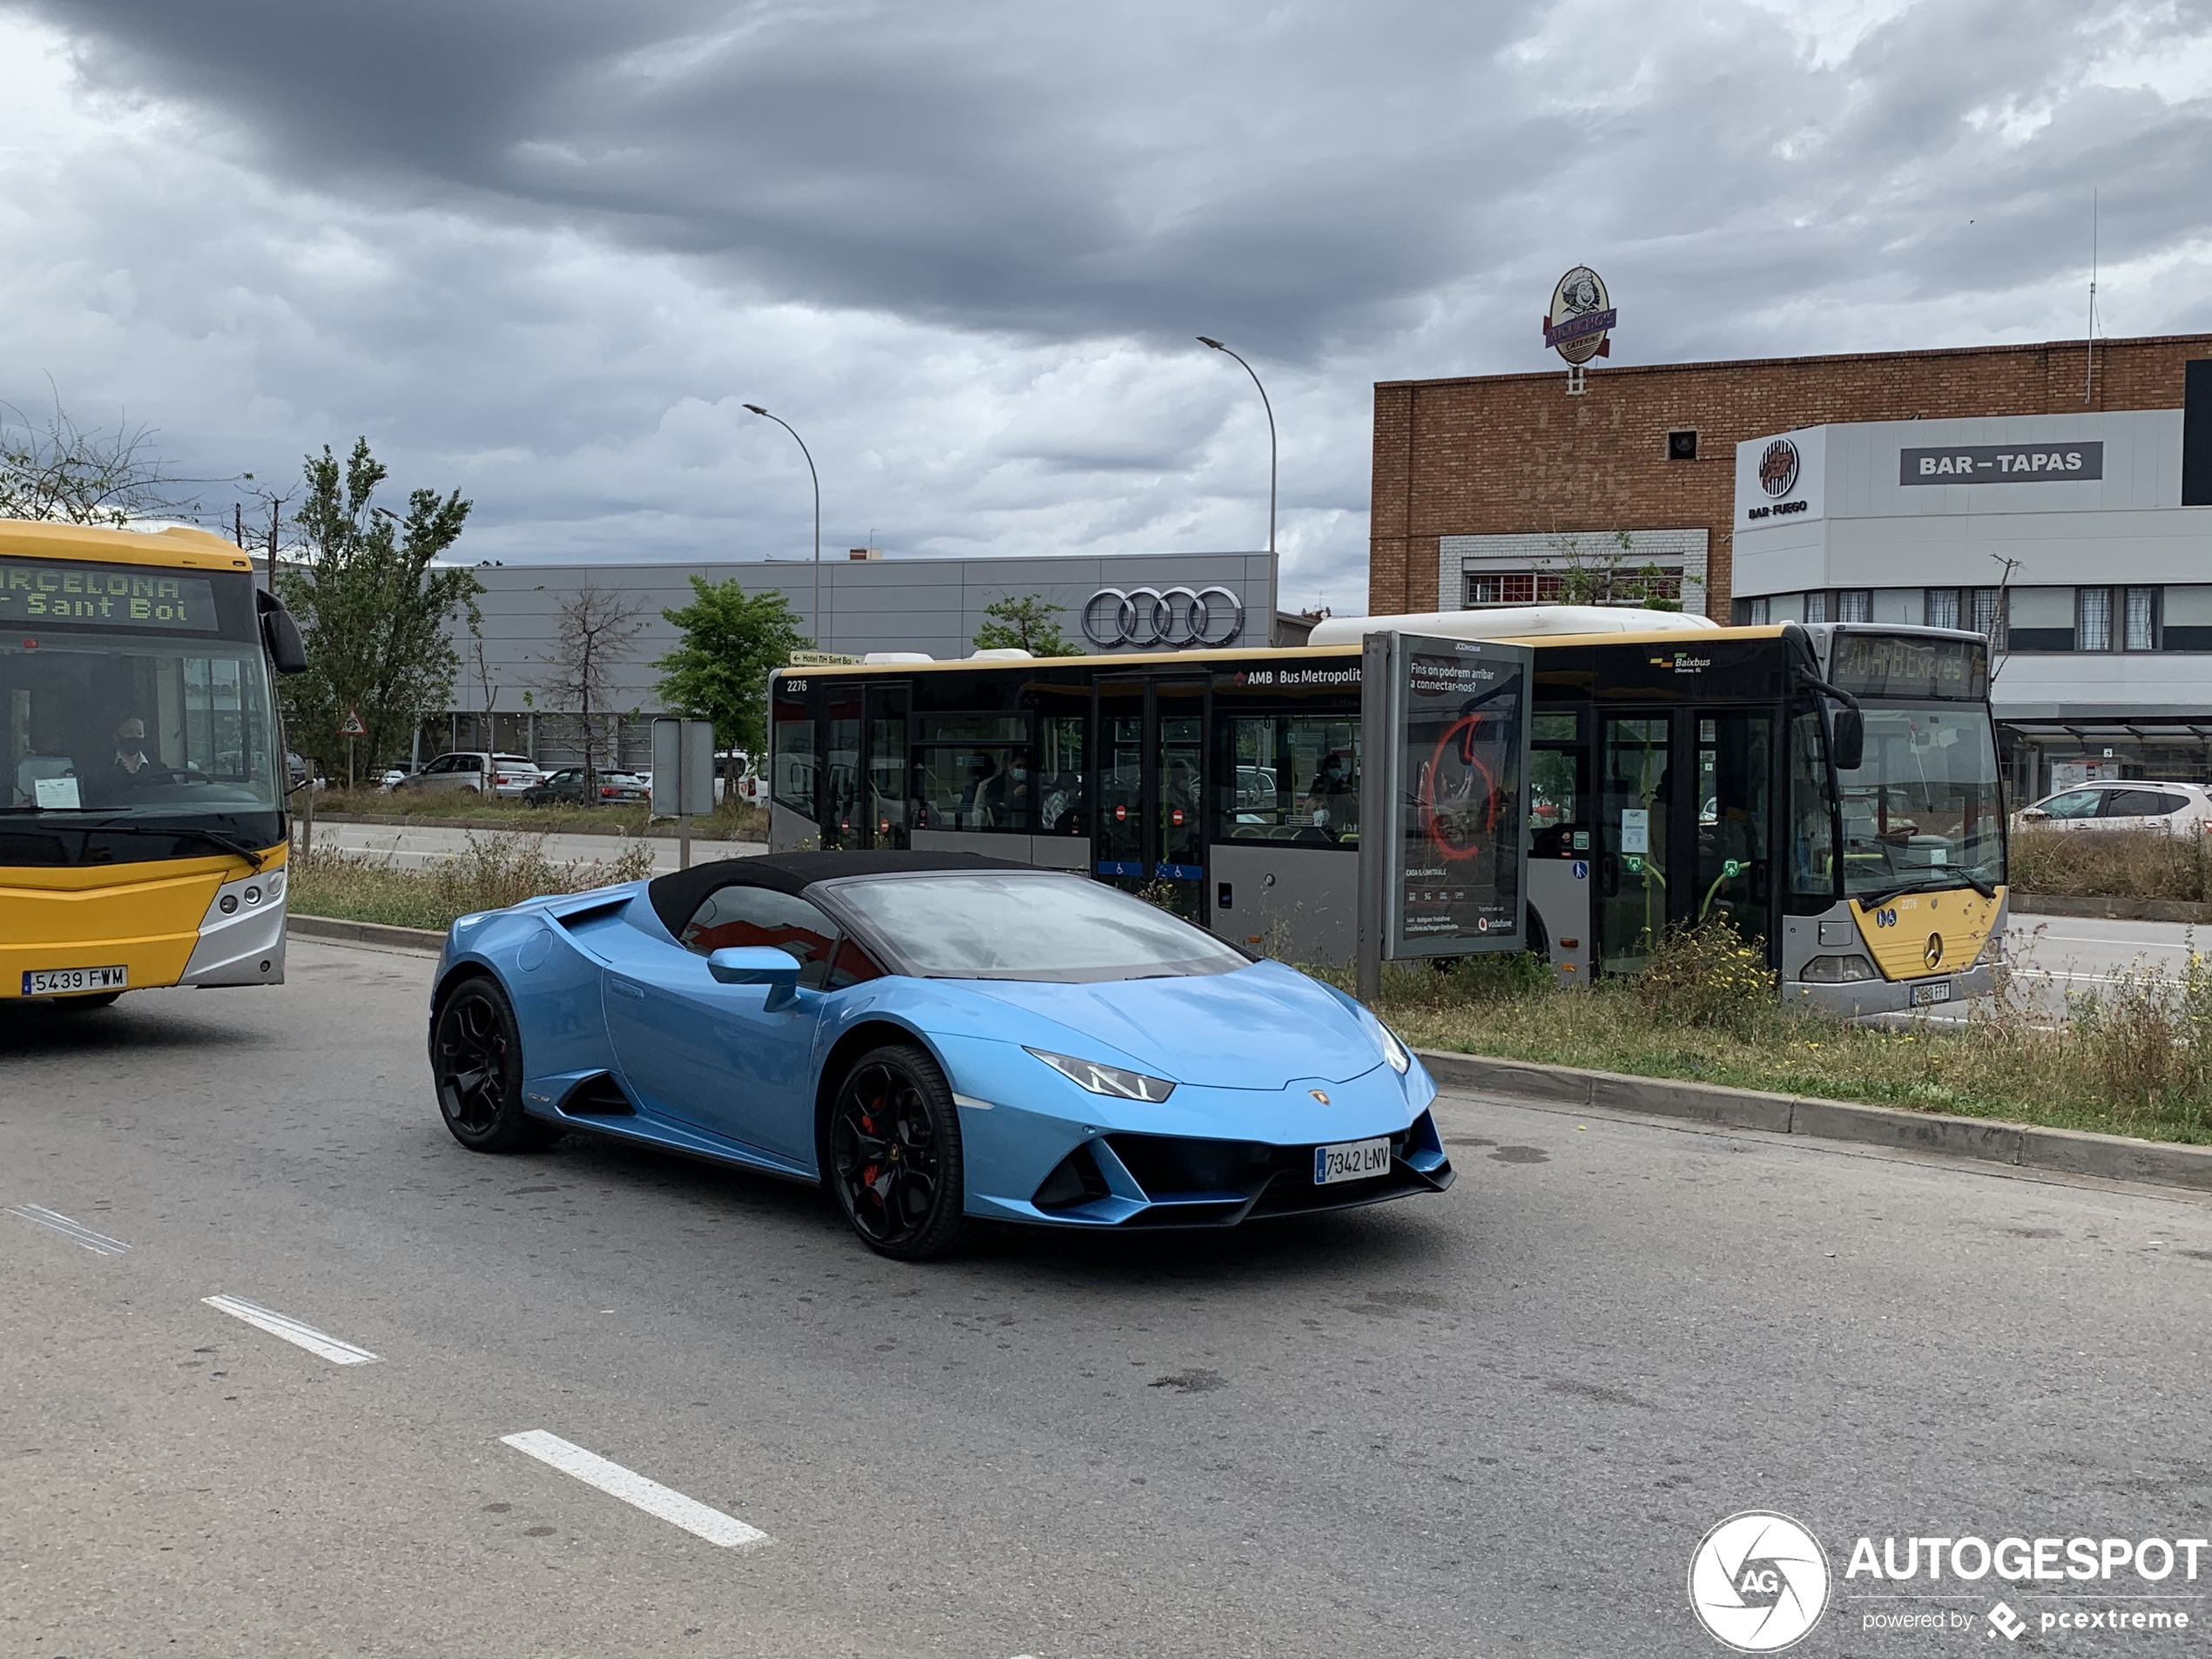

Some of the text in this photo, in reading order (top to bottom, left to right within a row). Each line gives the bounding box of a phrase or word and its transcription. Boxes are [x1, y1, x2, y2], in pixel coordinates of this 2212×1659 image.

[1550, 312, 1614, 341] MONCHO'S
[1566, 334, 1601, 351] CATERING
[1919, 455, 1973, 475] BAR
[1996, 452, 2082, 473] TAPAS
[1749, 500, 1808, 520] BAR-FUEGO
[0, 569, 179, 598] RCELONA
[27, 593, 187, 621] Sant Boi
[1454, 643, 1481, 652] JCDecaux
[802, 654, 819, 663] Hotel
[828, 656, 842, 664] Sant
[842, 657, 853, 665] Boi
[1675, 657, 1711, 667] Baixbus
[1247, 668, 1362, 685] AMB Bus Metropolit
[1411, 663, 1494, 680] Fins on podrem arribar
[786, 680, 807, 692] 2276
[1416, 679, 1476, 692] connectar-nos?
[1424, 892, 1432, 900] 5G
[1901, 899, 1918, 910] 2276
[1487, 919, 1513, 928] vodafone
[36, 968, 123, 991] 5439 FWM
[1935, 984, 1948, 999] FFT
[1327, 1146, 1388, 1176] 7342 LNV
[1318, 1169, 1324, 1177] E
